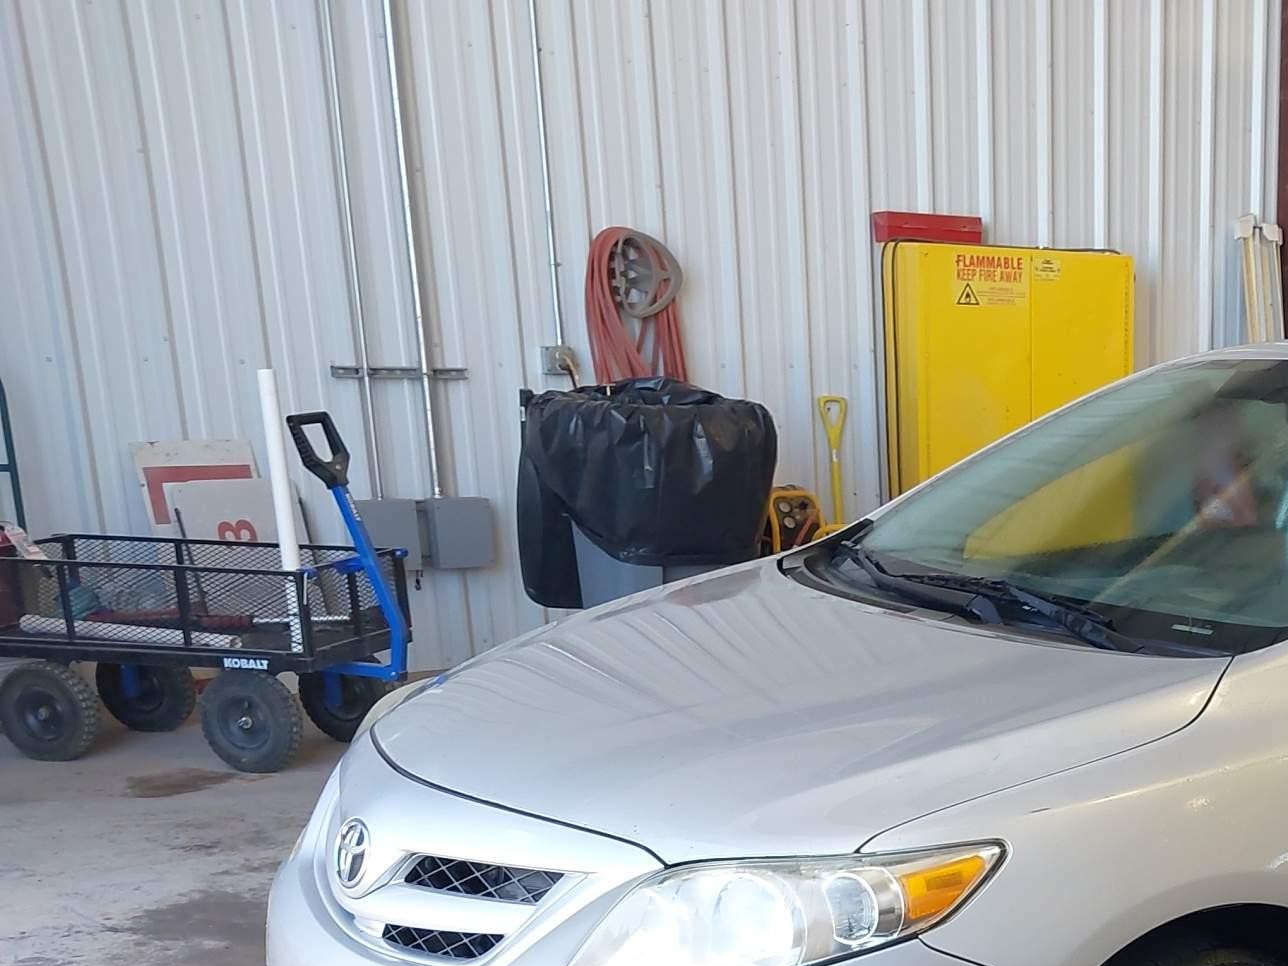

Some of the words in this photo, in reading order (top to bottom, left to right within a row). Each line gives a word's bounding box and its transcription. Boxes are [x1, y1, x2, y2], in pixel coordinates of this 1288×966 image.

[956, 254, 1023, 270] FLAMMABLE
[957, 268, 977, 281] KEEP
[979, 270, 997, 282] FIRE
[1000, 271, 1023, 283] AWAY
[223, 657, 269, 670] KOBALT
